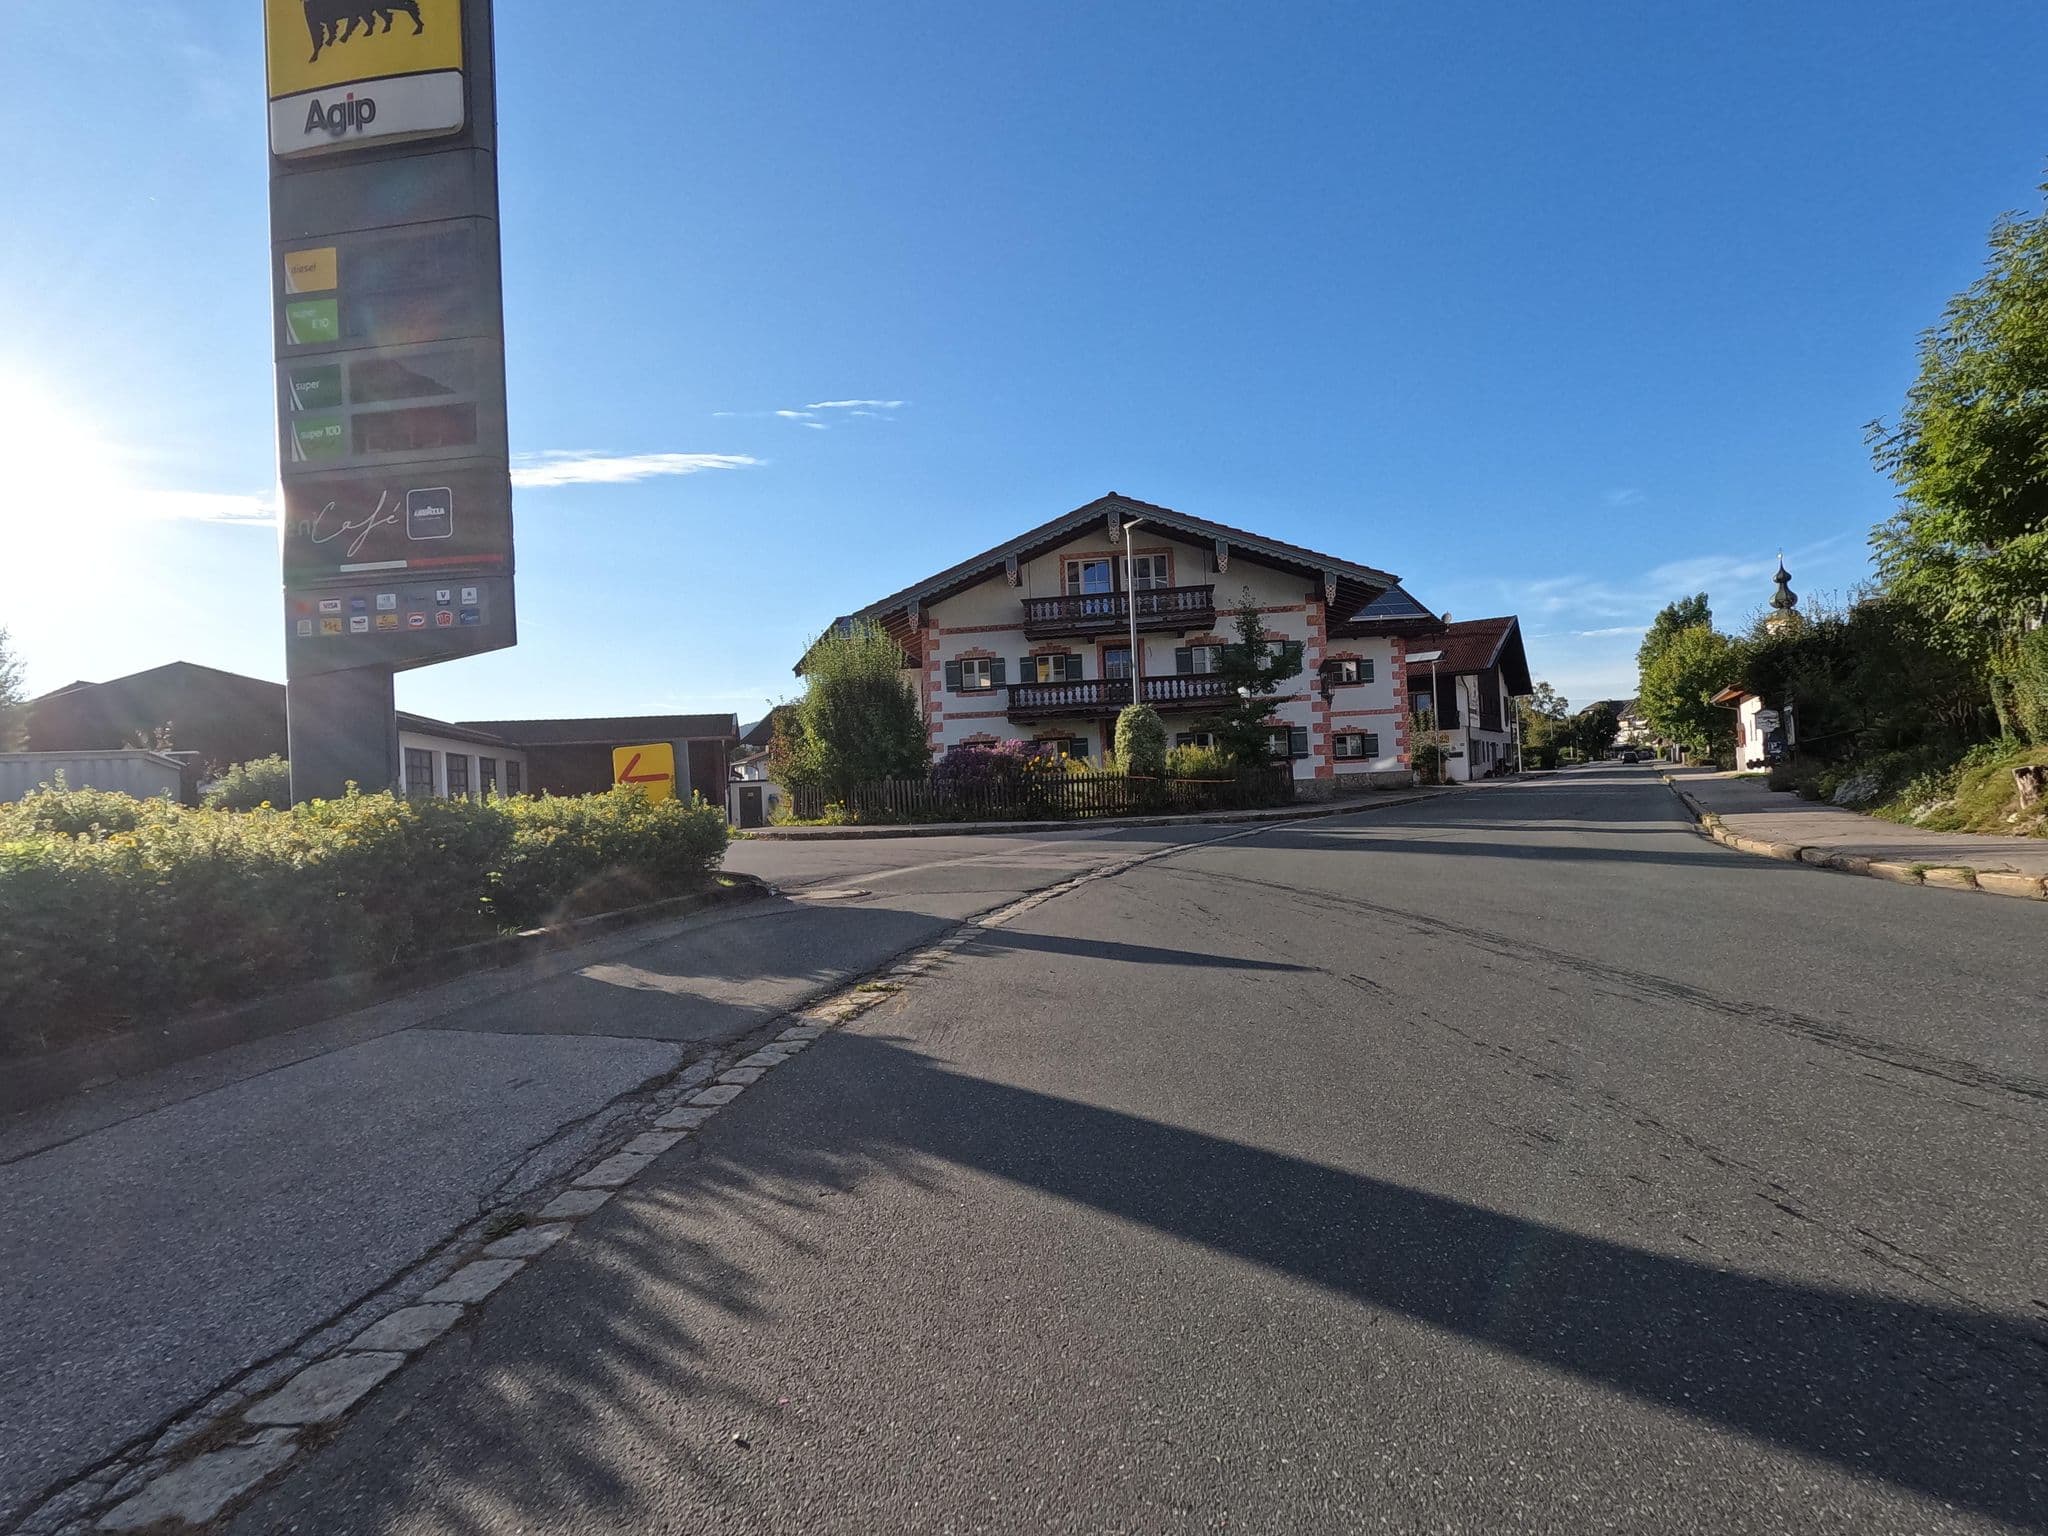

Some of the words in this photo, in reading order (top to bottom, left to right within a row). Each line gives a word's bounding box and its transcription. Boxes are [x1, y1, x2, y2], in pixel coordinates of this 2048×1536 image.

[304, 93, 376, 138] Agip
[295, 380, 319, 392] super
[300, 429, 324, 441] super
[325, 425, 341, 435] 100
[312, 489, 400, 557] Café
